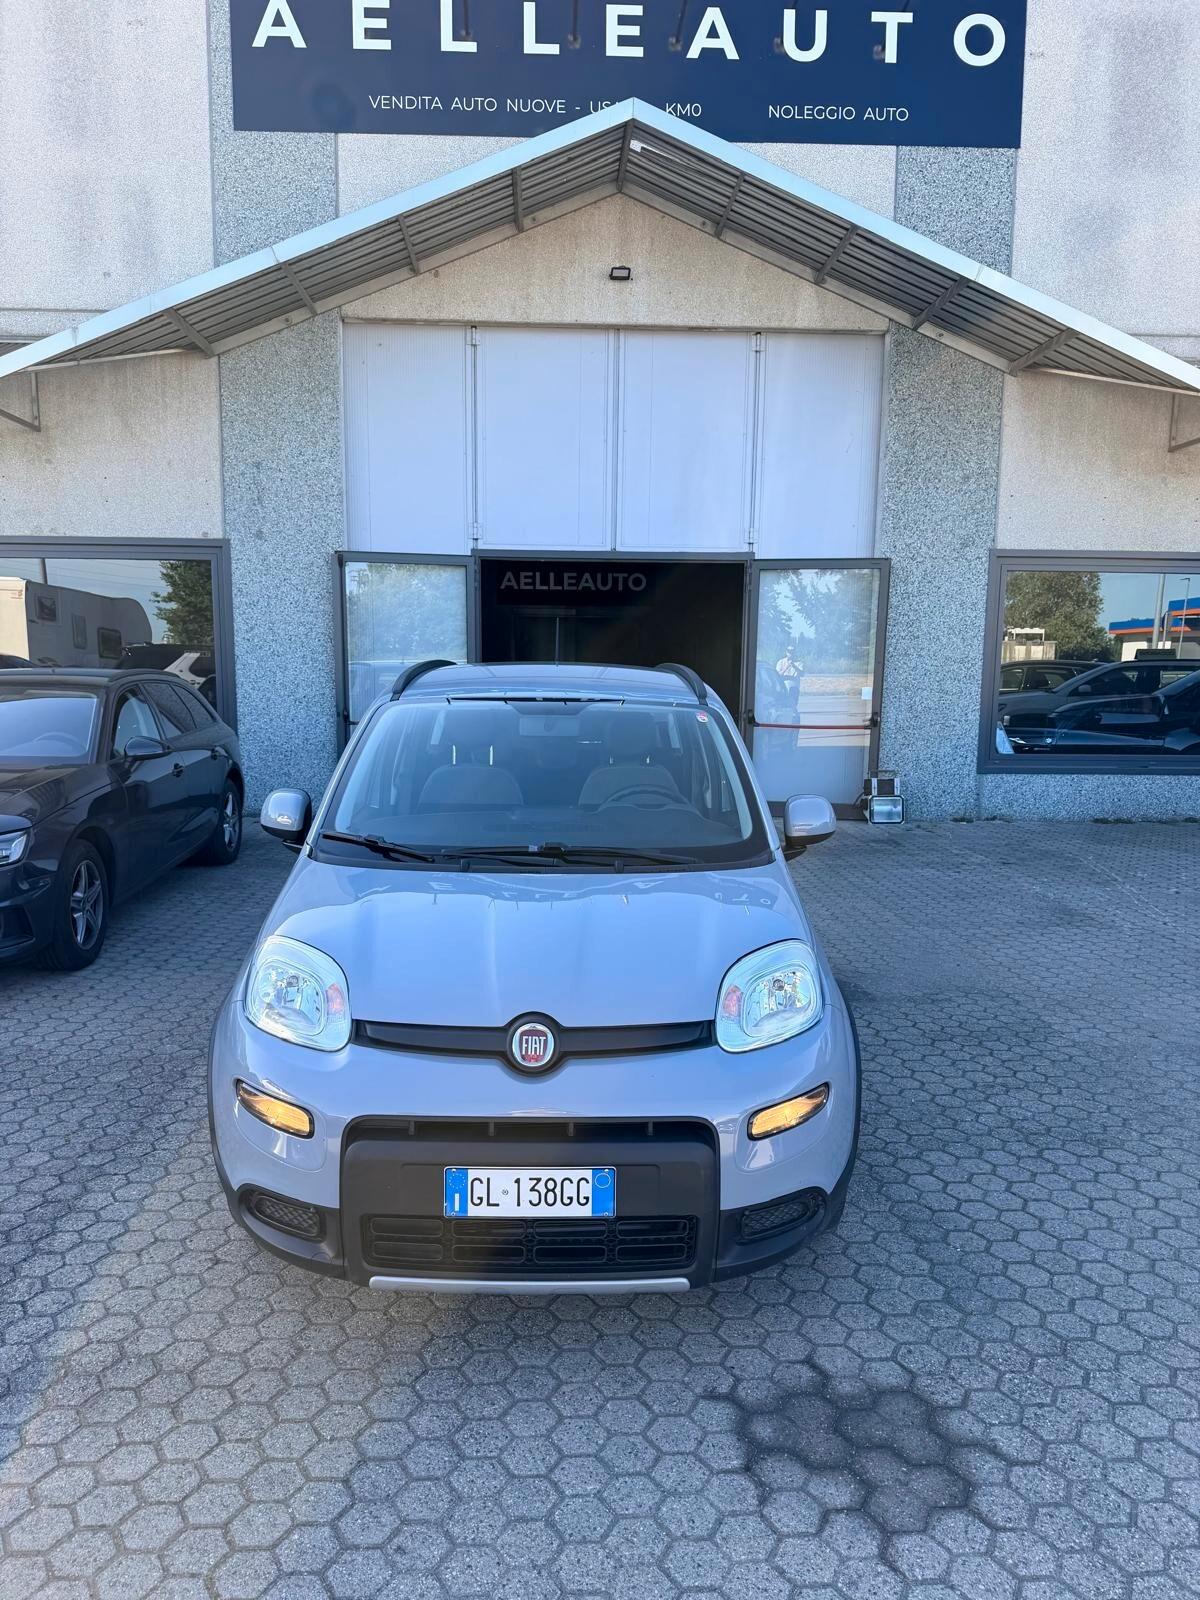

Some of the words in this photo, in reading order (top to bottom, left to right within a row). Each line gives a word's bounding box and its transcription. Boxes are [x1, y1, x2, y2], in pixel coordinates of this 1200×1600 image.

[252, 0, 1006, 67] AELLEAUTO
[368, 95, 443, 111] VENDITA
[451, 97, 498, 112] AUTO
[507, 98, 566, 114] NUOVE
[768, 104, 856, 121] NOLEGGIO
[863, 106, 910, 122] AUTO
[500, 571, 647, 592] AELLEAUTO
[522, 1035, 547, 1056] FIAT
[470, 1177, 499, 1207] GL
[514, 1177, 590, 1207] 138GG
